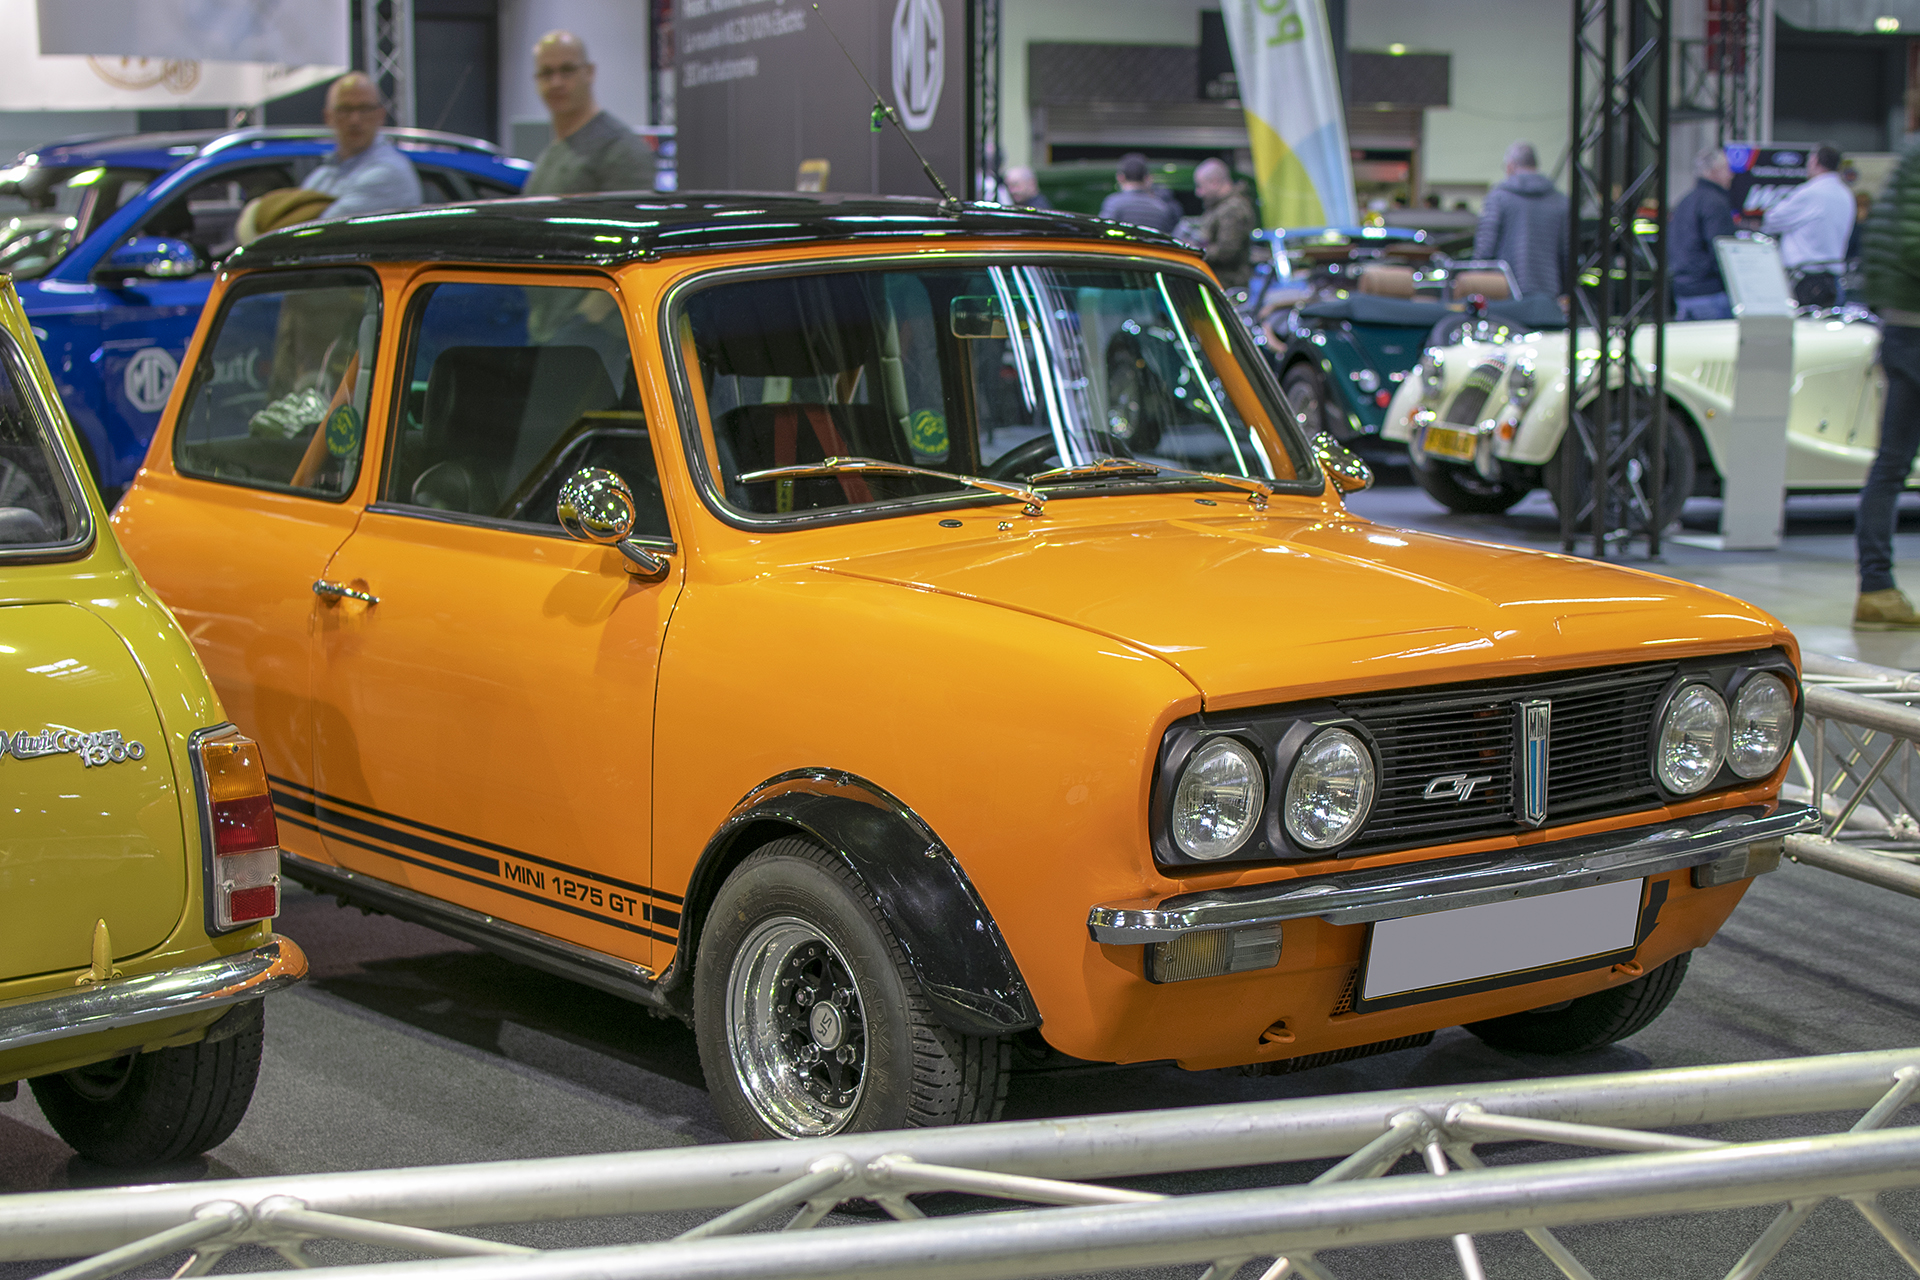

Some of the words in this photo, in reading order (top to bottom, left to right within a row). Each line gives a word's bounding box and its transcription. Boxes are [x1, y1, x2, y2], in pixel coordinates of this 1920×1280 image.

[127, 350, 177, 409] MG
[1528, 706, 1548, 738] MINI
[79, 740, 146, 768] 1300
[1424, 773, 1492, 801] GT
[504, 862, 545, 890] MINI
[552, 876, 603, 907] 1275
[609, 892, 637, 916] GT
